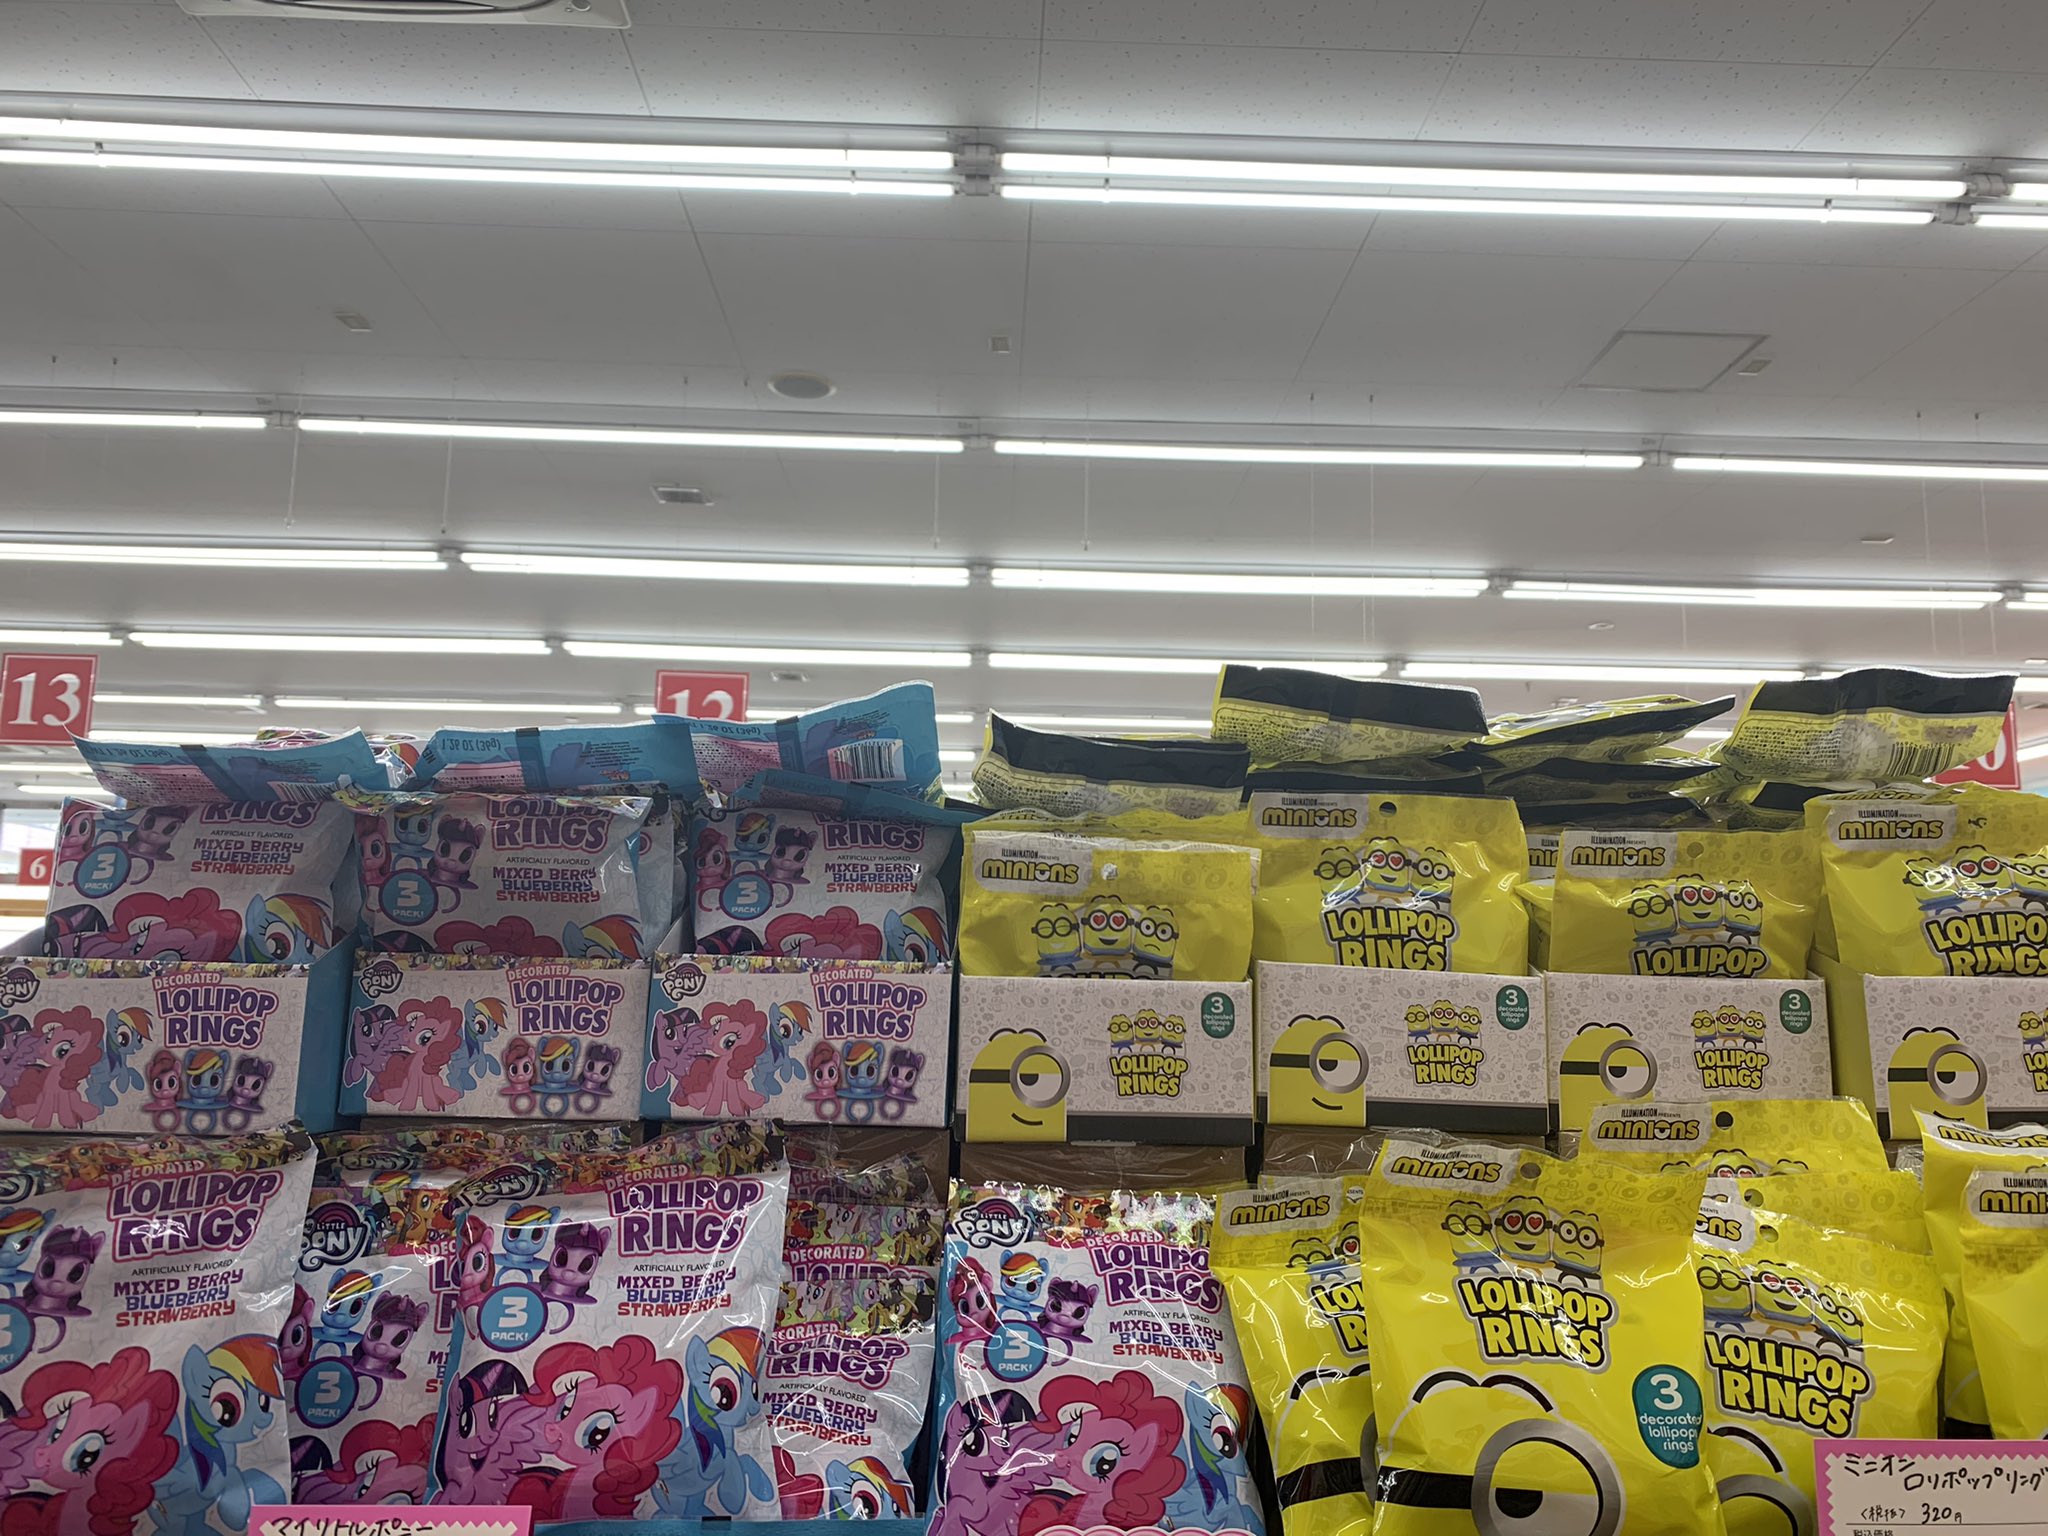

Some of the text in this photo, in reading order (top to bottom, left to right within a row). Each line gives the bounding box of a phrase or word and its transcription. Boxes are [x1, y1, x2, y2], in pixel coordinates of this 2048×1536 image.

[8, 671, 81, 726] 13
[203, 799, 318, 826] RINGS
[1261, 807, 1357, 828] minions
[1858, 809, 1899, 819] ILLUMINATION
[494, 817, 607, 852] RINGS
[826, 822, 923, 851] RINGS
[1839, 819, 1944, 840] minions
[193, 839, 304, 853] MIXED BERRY
[200, 850, 292, 863] BLUEBERRY
[1001, 848, 1039, 860] ILLUMINATION
[1571, 846, 1666, 867] minions
[30, 855, 47, 880] 6
[91, 853, 116, 880] 3
[190, 861, 295, 875] STRAWBERRY
[506, 856, 591, 866] ARTIFICIALLY FLAVORED
[824, 863, 921, 875] MIXED BERRY
[982, 858, 1079, 884] minions
[492, 867, 597, 881] MIXED BERRY
[502, 879, 593, 892] BLUEBERRY
[832, 873, 914, 884] BLUEBERRY
[396, 880, 421, 907] 3
[496, 889, 600, 903] STRAWBERRY
[734, 880, 760, 905] 3
[826, 882, 919, 895] STRAWBERRY
[392, 909, 424, 918] PACK!
[730, 906, 760, 915] PACK!
[1325, 906, 1454, 943] LOLLIPOP
[1924, 911, 2048, 953] LOLLIPO
[1339, 937, 1448, 972] RINGS
[1633, 944, 1767, 978] LOLLIPOP
[153, 973, 220, 990] DECORATED
[361, 972, 403, 994] PONY
[507, 964, 570, 980] DECORATED
[811, 968, 873, 984] DECORATED
[512, 977, 622, 1006] LOLLIPOP
[662, 975, 704, 997] PONY
[814, 981, 925, 1011] LOLLIPOP
[1505, 989, 1518, 1006] 3
[158, 986, 277, 1018] LOLLIPOP
[1210, 996, 1224, 1013] 3
[1788, 993, 1801, 1010] 3
[168, 1015, 262, 1047] RINGS
[521, 1004, 610, 1034] RINGS
[826, 1008, 912, 1039] RINGS
[1109, 1054, 1189, 1079] LOLLIPOP
[1406, 1044, 1484, 1067] LOLLIPOP
[1693, 1048, 1769, 1071] LOLLIPOP
[1118, 1074, 1181, 1098] RINGS
[1415, 1063, 1477, 1086] RINGS
[1703, 1066, 1763, 1090] RINGS
[1621, 1108, 1658, 1118] ILLUMINATION
[1597, 1119, 1700, 1141] minions
[112, 1160, 205, 1185] DECORATED
[606, 1164, 688, 1189] DECORATED
[1391, 1156, 1504, 1183] minions
[112, 1170, 281, 1217] LOLLIPOP
[611, 1179, 760, 1215] LOLLIPOP
[1979, 1189, 2048, 1215] mini
[1230, 1195, 1331, 1226] minions
[118, 1206, 261, 1258] RINGS
[622, 1211, 746, 1253] RINGS
[958, 1218, 1026, 1245] PONY
[1087, 1229, 1164, 1248] DECORATED
[790, 1245, 866, 1264] DECORATED
[1091, 1243, 1212, 1276] LOLLIPO
[131, 1258, 234, 1277] ARTIFICIALLY FLAVORED
[616, 1267, 737, 1290] MIXED BERRY
[633, 1264, 685, 1273] ARTIFICIALLY
[113, 1268, 244, 1298] MIXED BERRY
[626, 1282, 727, 1304] BLUEBERRY
[1108, 1268, 1223, 1312] RINGS
[125, 1285, 230, 1312] BLUEBERRY
[617, 1293, 732, 1318] STRAWBERRY
[1457, 1276, 1613, 1327] LOLLIPOP
[115, 1299, 236, 1328] STRAWBERRY
[499, 1296, 529, 1328] 3
[490, 1331, 530, 1342] PACK!
[1109, 1321, 1224, 1341] MIXED BERRY
[1119, 1332, 1217, 1351] BLUEBERRY
[1003, 1329, 1031, 1361] 3
[1112, 1343, 1224, 1364] STRAWBERRY
[771, 1351, 890, 1386] RINGS
[998, 1363, 1033, 1373] PACK!
[1704, 1331, 1870, 1400] LOLLIPOP
[313, 1370, 342, 1405] 3
[779, 1383, 867, 1404] ARTIFICIALLY FLAVORED
[1650, 1373, 1684, 1411] 3
[305, 1407, 341, 1419] PACK!
[762, 1391, 878, 1424] MIXED BERRY
[1719, 1366, 1855, 1438] RINGS
[771, 1402, 866, 1434] BLUEBERRY
[1663, 1439, 1694, 1454] rings
[1843, 1452, 1916, 1477] ミニオン
[1904, 1465, 2048, 1495] ロリポップリング
